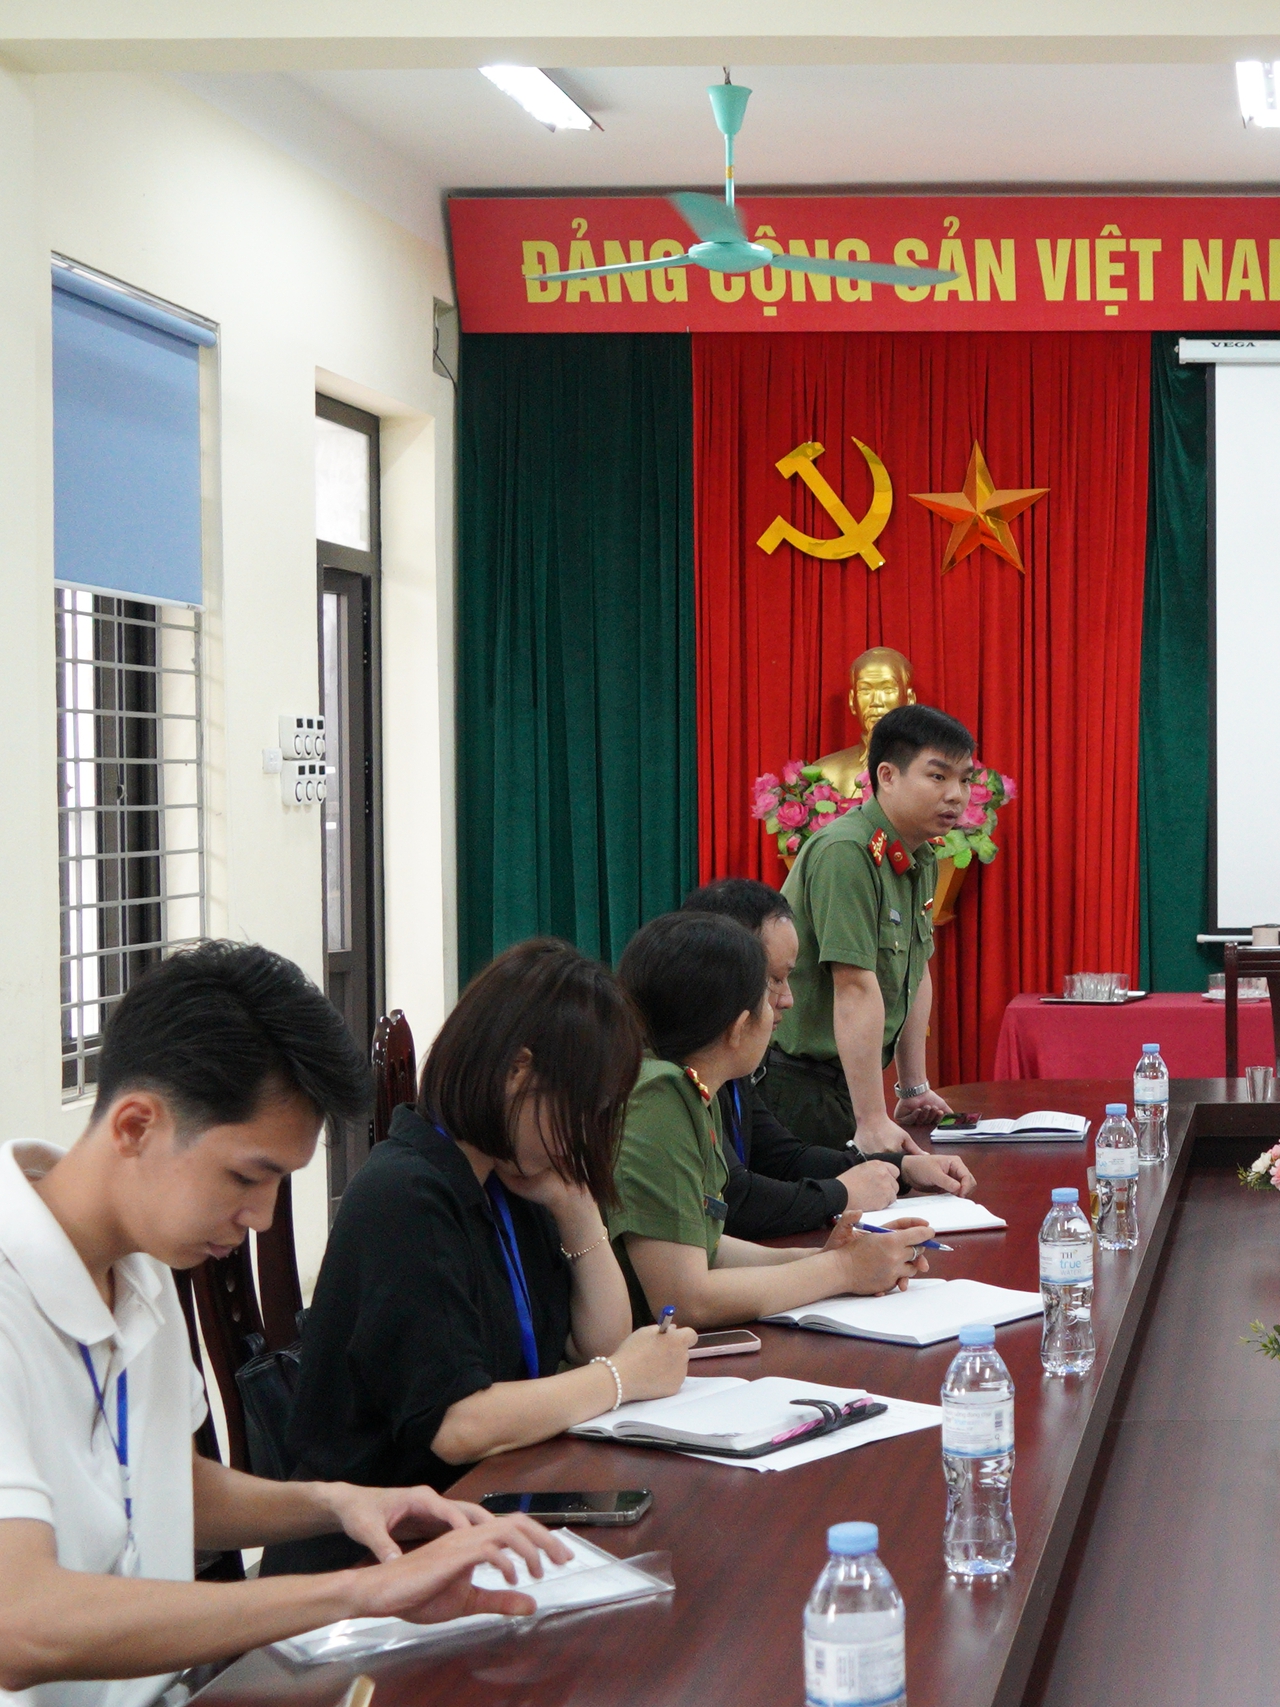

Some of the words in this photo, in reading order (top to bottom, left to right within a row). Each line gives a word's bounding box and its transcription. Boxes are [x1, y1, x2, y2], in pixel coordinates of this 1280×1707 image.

[522, 217, 689, 303] ĐẢNG
[893, 216, 1017, 303] SẢN
[1035, 224, 1163, 316] VIỆT
[1060, 1260, 1082, 1269] true
